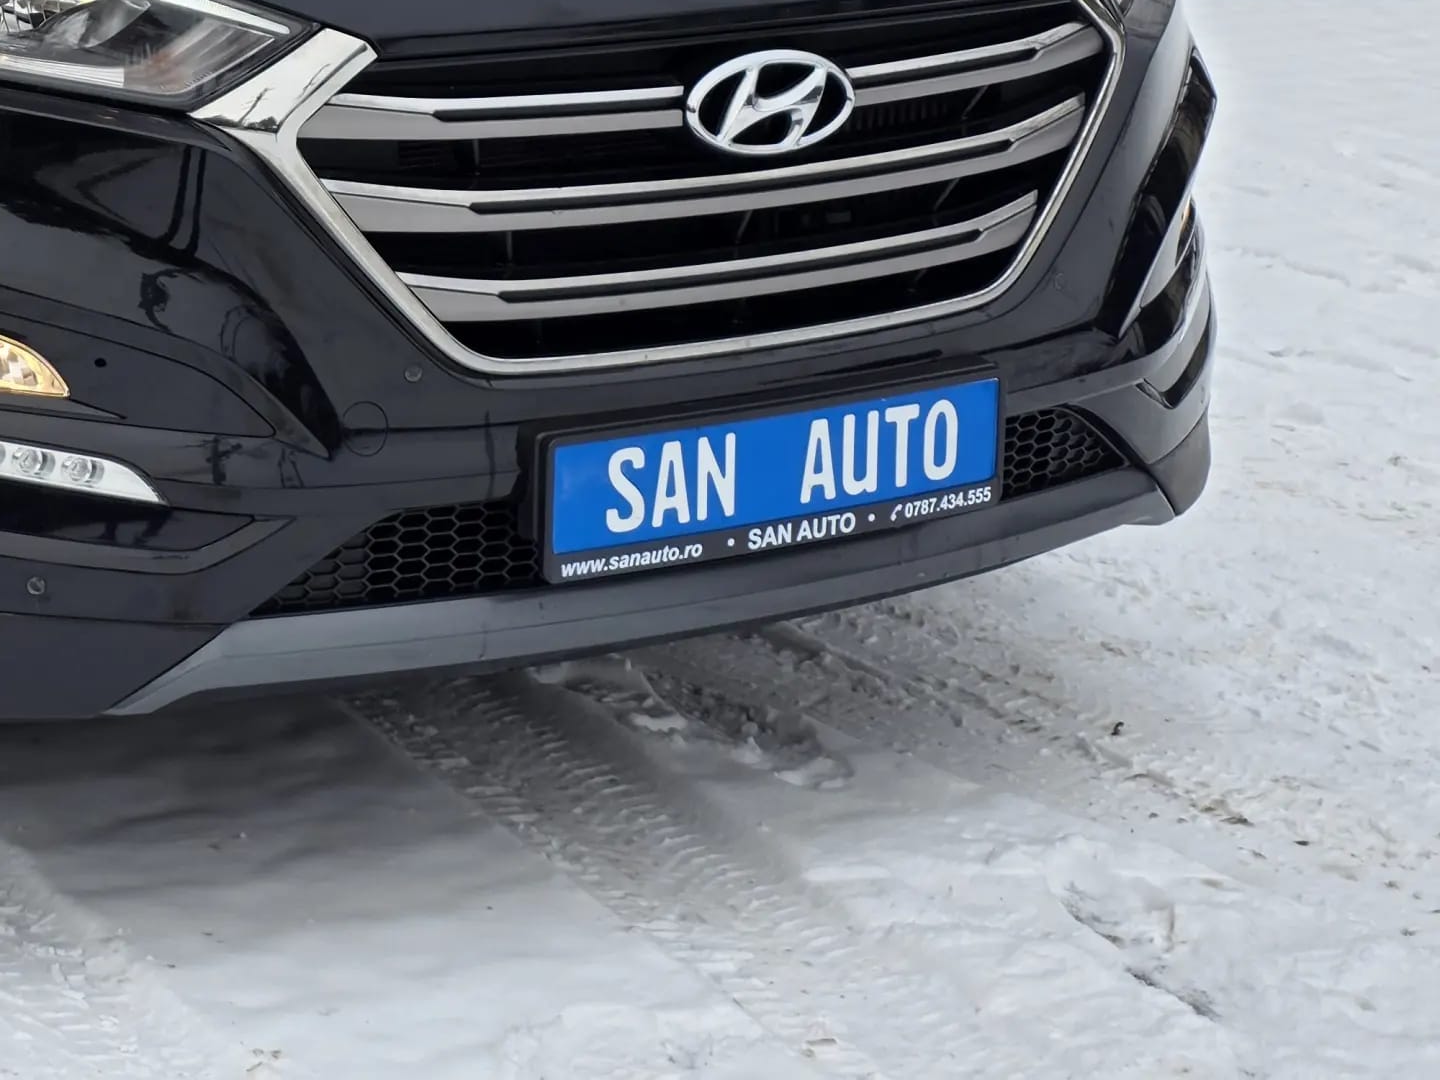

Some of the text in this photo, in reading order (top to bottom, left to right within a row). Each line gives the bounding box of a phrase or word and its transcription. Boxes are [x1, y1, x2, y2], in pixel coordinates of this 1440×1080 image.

[605, 399, 958, 532] SAN AUTO
[561, 486, 992, 577] www.sanauto.ro SAN AUTO 0787.434.555
